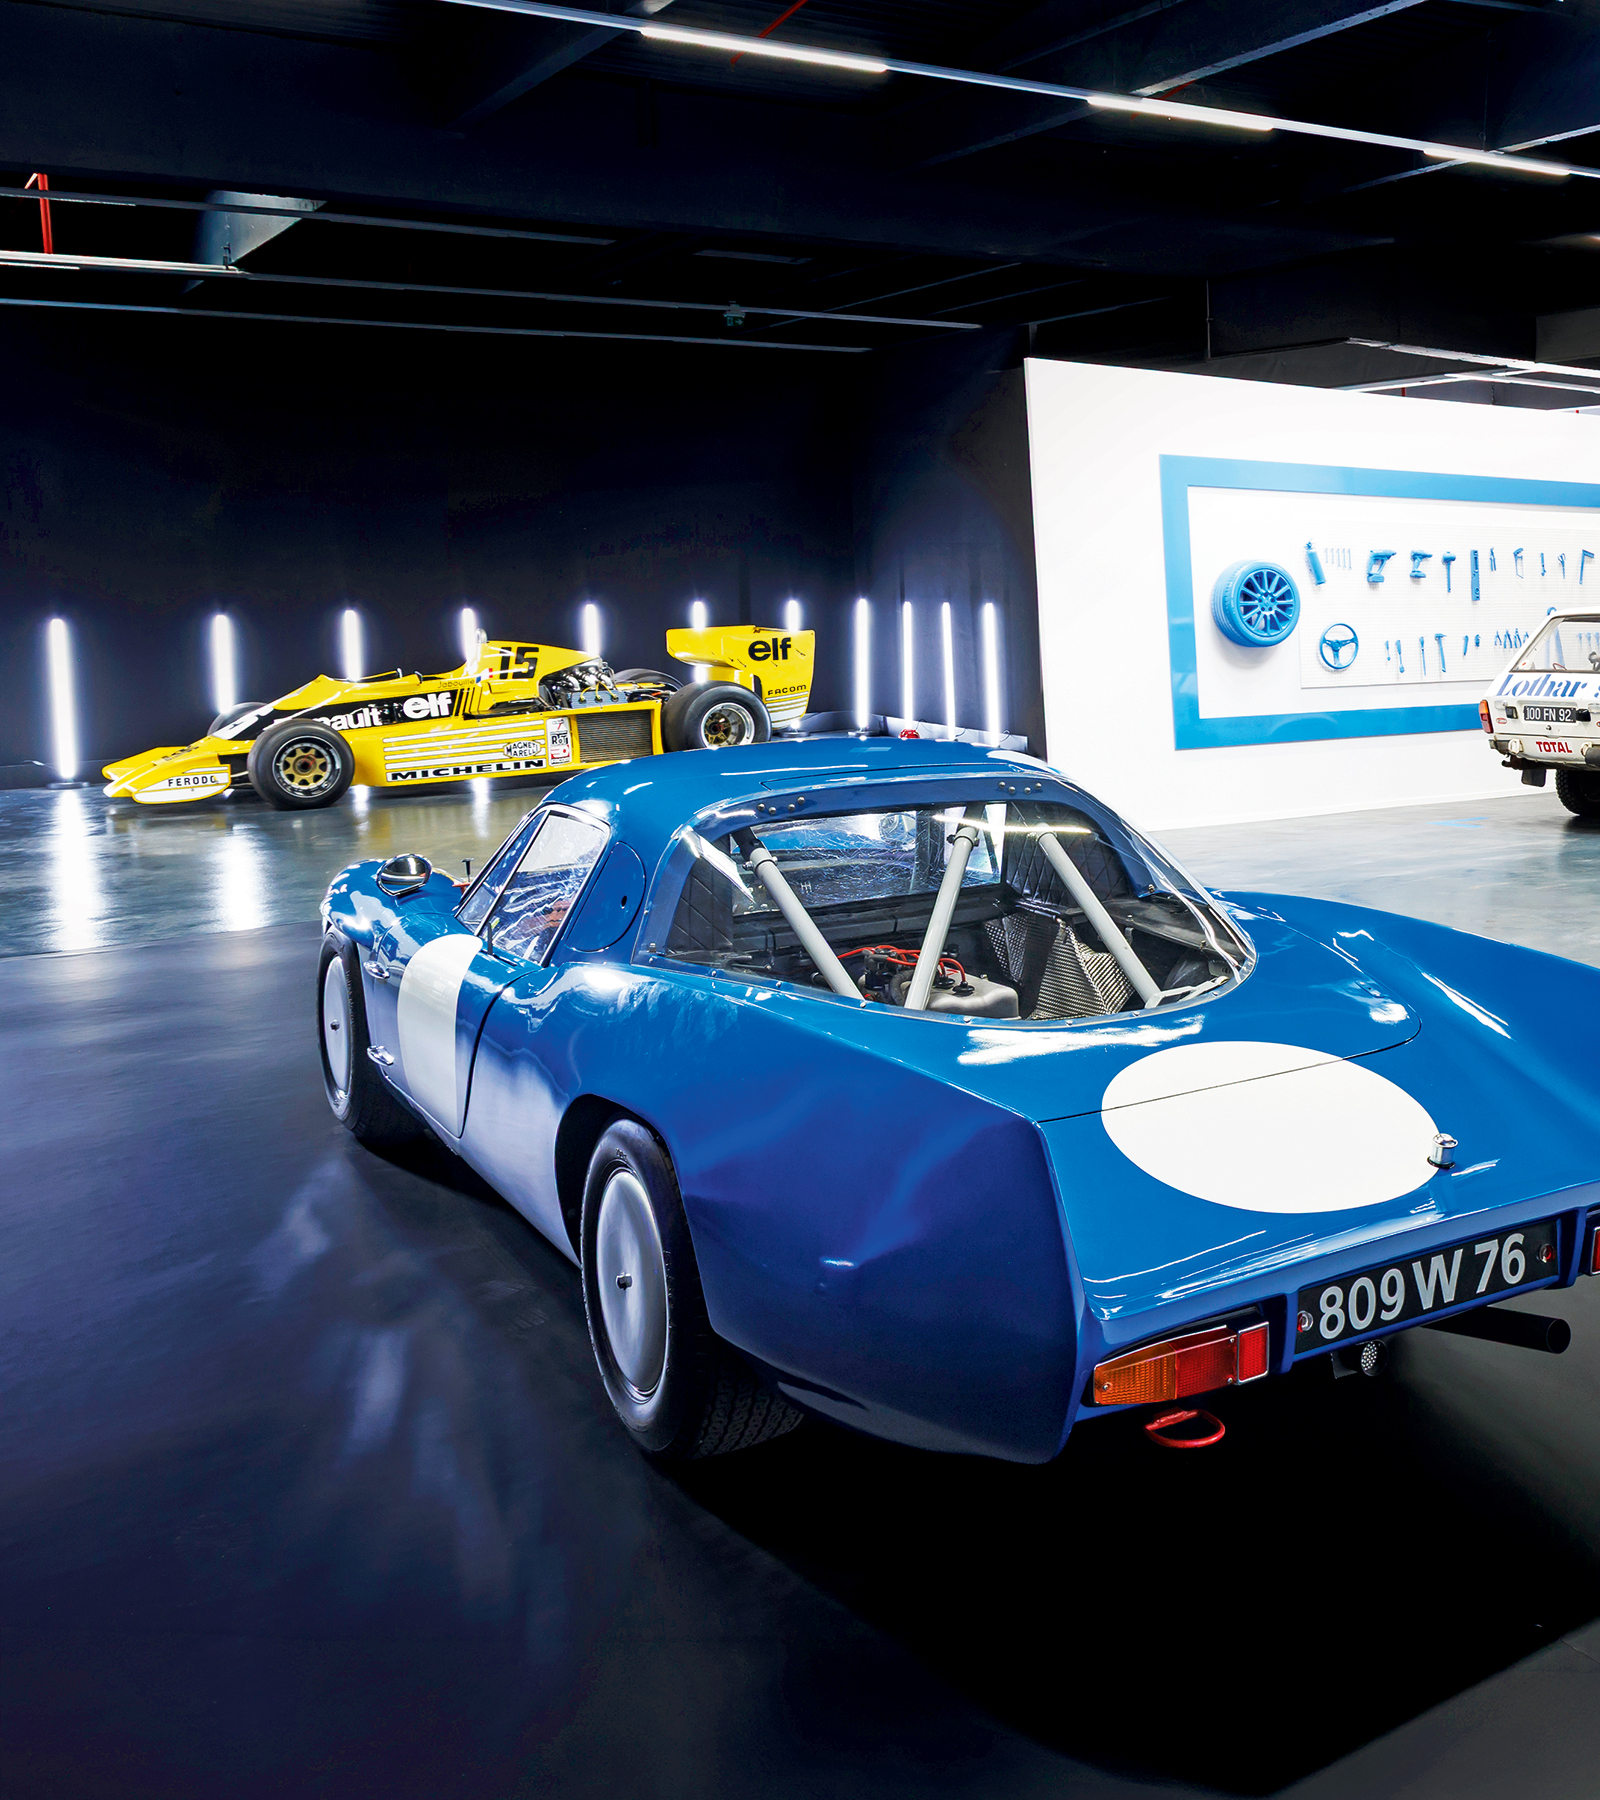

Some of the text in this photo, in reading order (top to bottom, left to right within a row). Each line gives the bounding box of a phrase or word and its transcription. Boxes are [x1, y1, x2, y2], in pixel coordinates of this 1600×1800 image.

[748, 637, 792, 661] elf
[499, 646, 539, 679] 15
[438, 679, 475, 689] Jabouille
[767, 684, 807, 696] FACOM
[402, 691, 452, 719] elf
[1525, 706, 1572, 722] 100 FN 92
[1536, 741, 1573, 753] TOTAL
[391, 759, 544, 781] MICHELIN
[1319, 1232, 1526, 1340] 809 W 76
